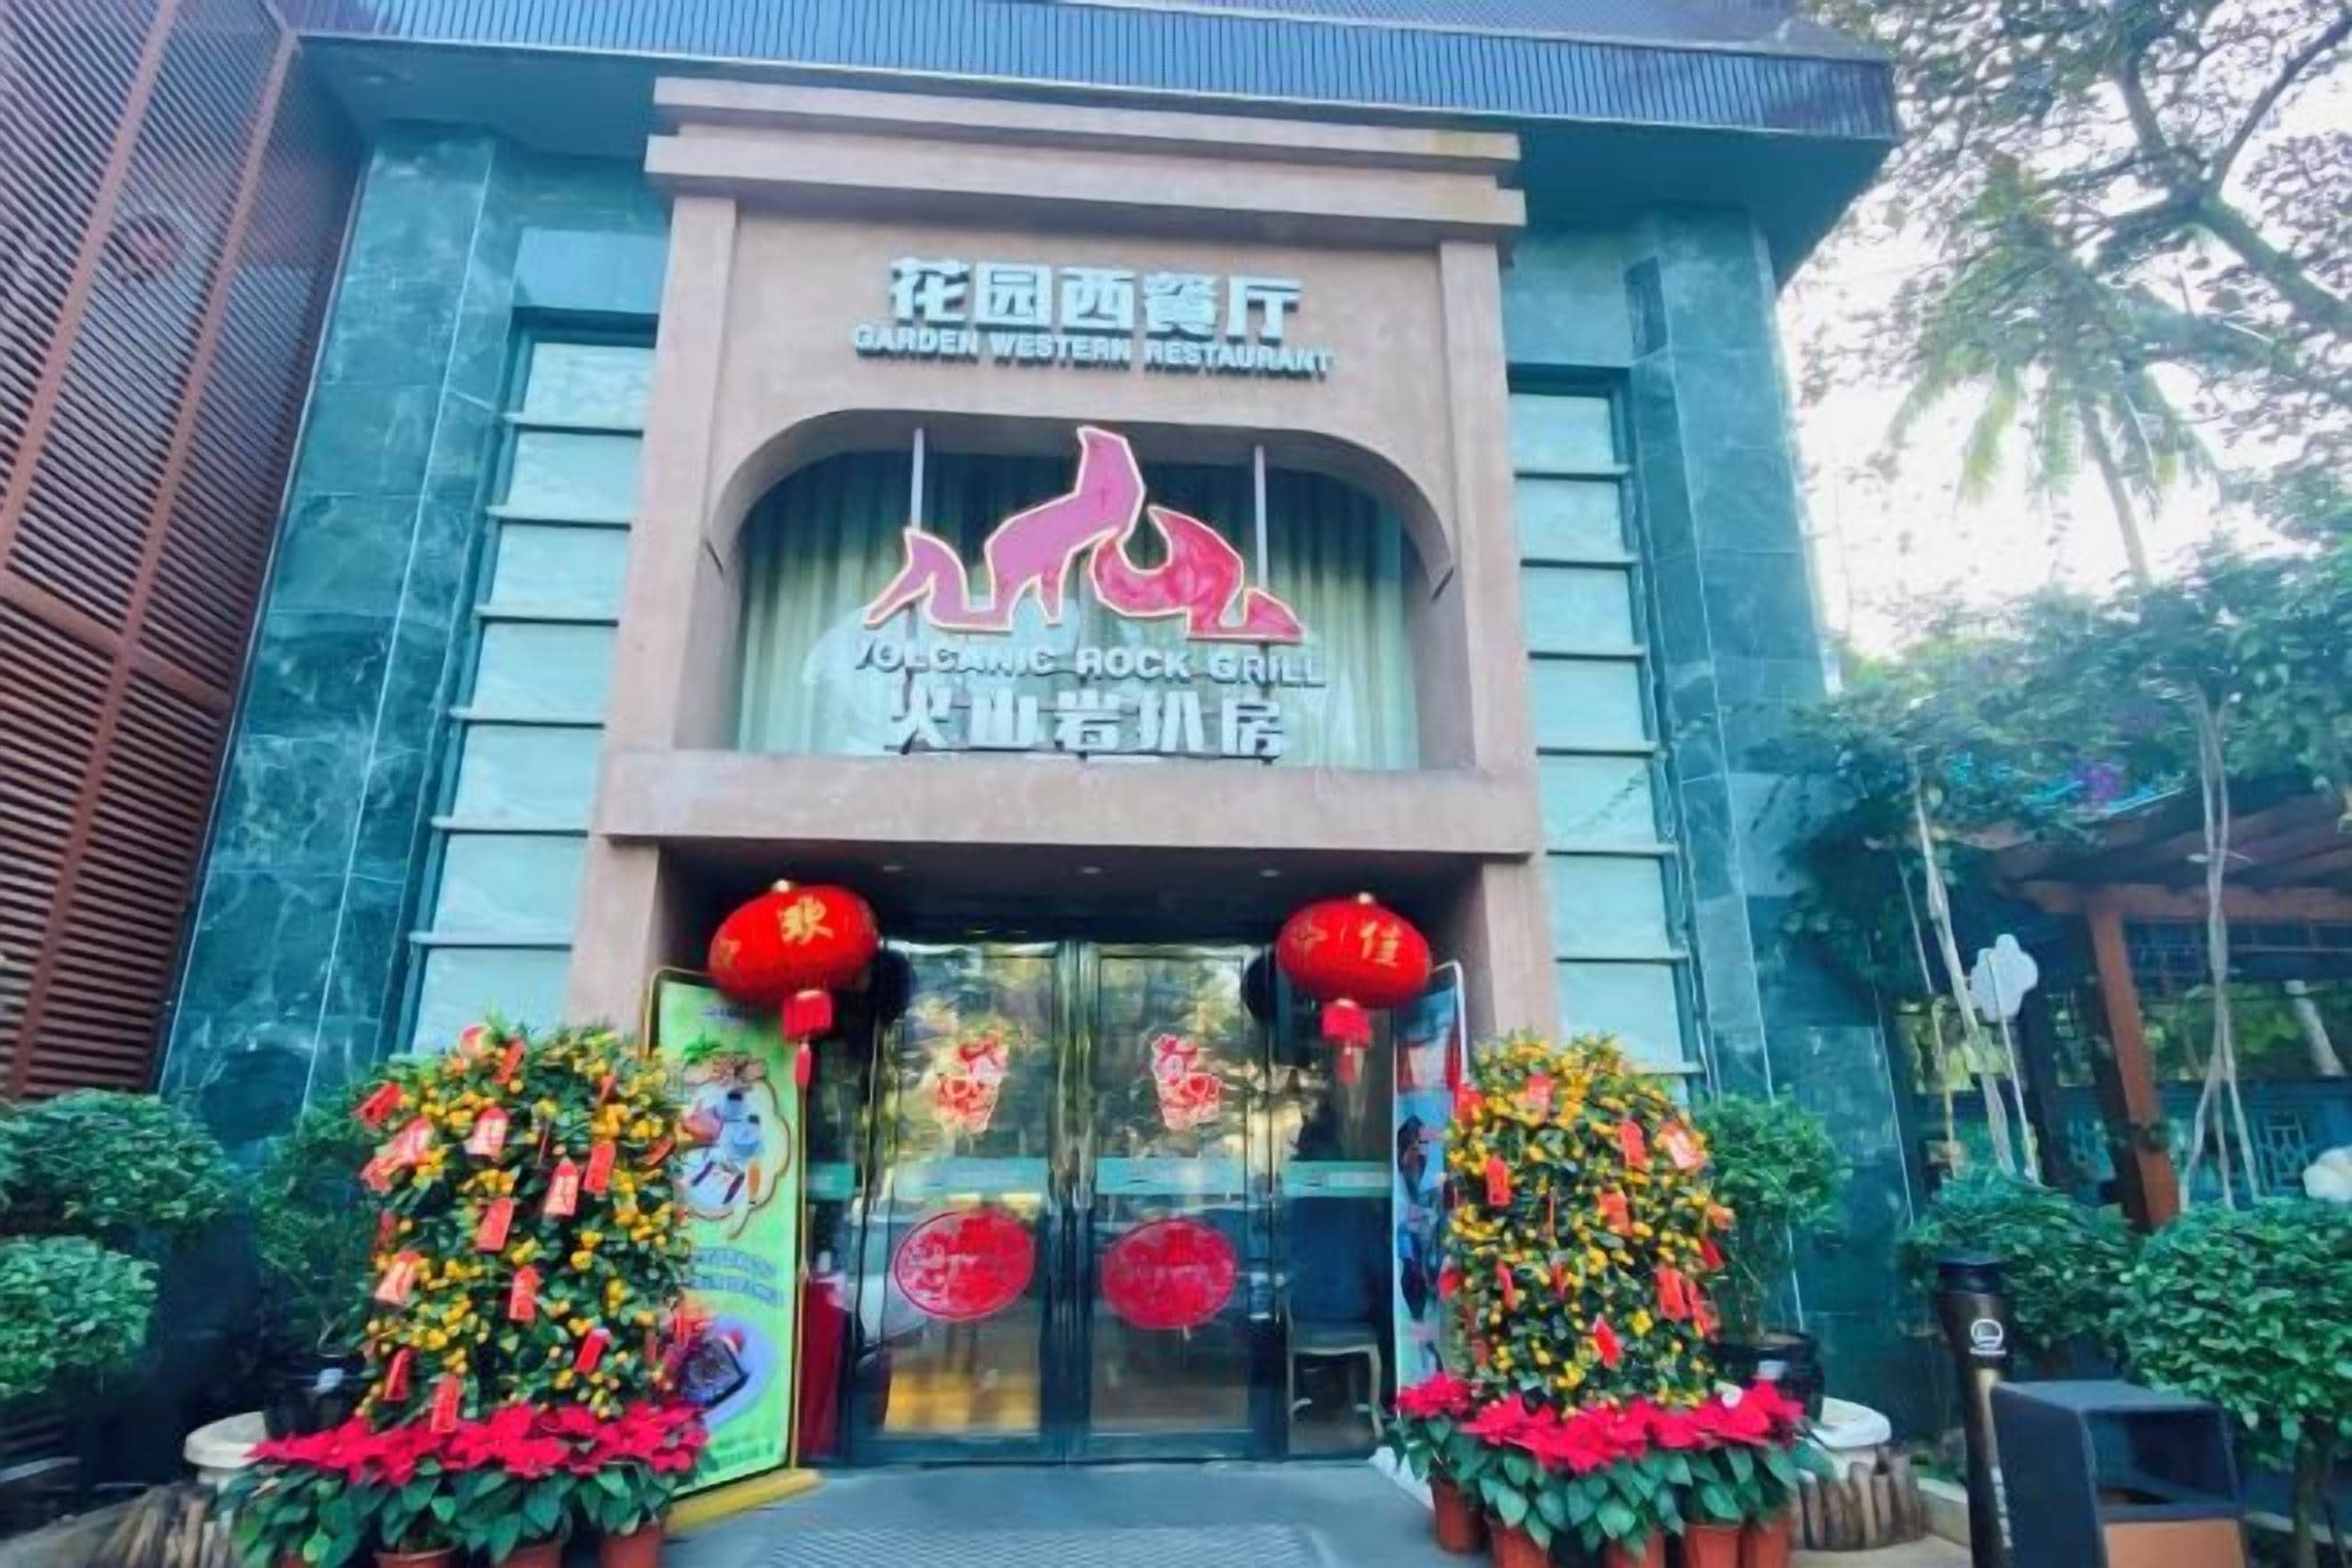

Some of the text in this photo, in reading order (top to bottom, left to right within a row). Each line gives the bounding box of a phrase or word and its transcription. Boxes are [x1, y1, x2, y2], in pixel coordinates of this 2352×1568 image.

[891, 257, 1303, 342] 花园西餐厅
[854, 323, 1327, 378] GARDEN WESTERN RESTAURANT
[1075, 647, 1192, 682] ROCK
[1207, 653, 1326, 687] GRILL
